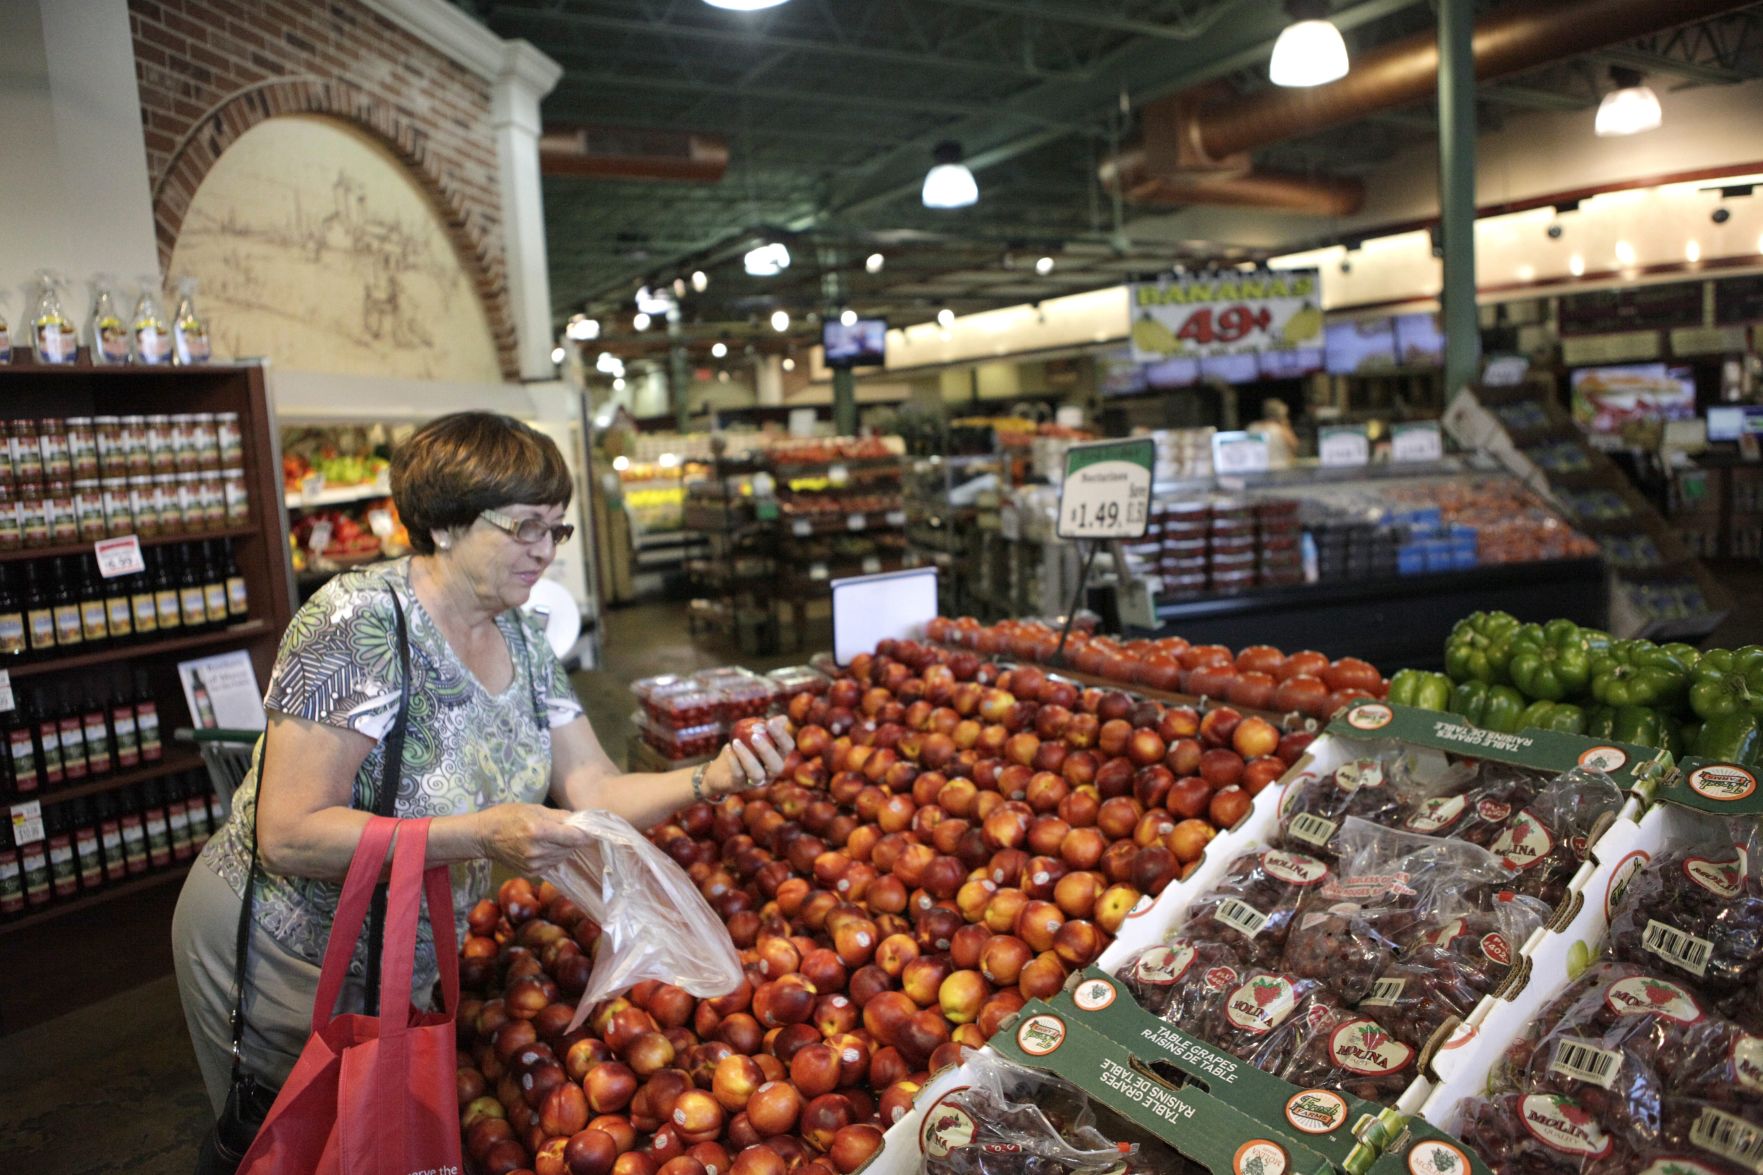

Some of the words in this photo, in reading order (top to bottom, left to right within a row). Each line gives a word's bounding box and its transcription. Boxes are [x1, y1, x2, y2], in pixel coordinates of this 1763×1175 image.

[1138, 276, 1313, 305] BANANAS
[1433, 721, 1468, 735] TABLE
[1436, 729, 1482, 745] GRAPES
[1472, 728, 1487, 739] DE
[1487, 731, 1533, 747] RAISINS
[1481, 739, 1519, 752] TABLE
[1266, 857, 1309, 880] MOLINA
[1141, 1029, 1184, 1056] RAISINS
[1182, 1051, 1200, 1065] DE
[1200, 1060, 1238, 1084] TABLE
[1157, 1026, 1192, 1050] TABLE
[1191, 1045, 1238, 1073] GRAPES
[1336, 1045, 1389, 1069] MOLINA
[1100, 1058, 1135, 1083] TABLE
[1100, 1071, 1144, 1101] GRAPES
[1133, 1077, 1152, 1092] DE
[1141, 1095, 1180, 1124] TABLE
[1149, 1086, 1196, 1119] RAISINS
[1295, 1107, 1329, 1121] FARMS
[439, 1165, 458, 1175] the
